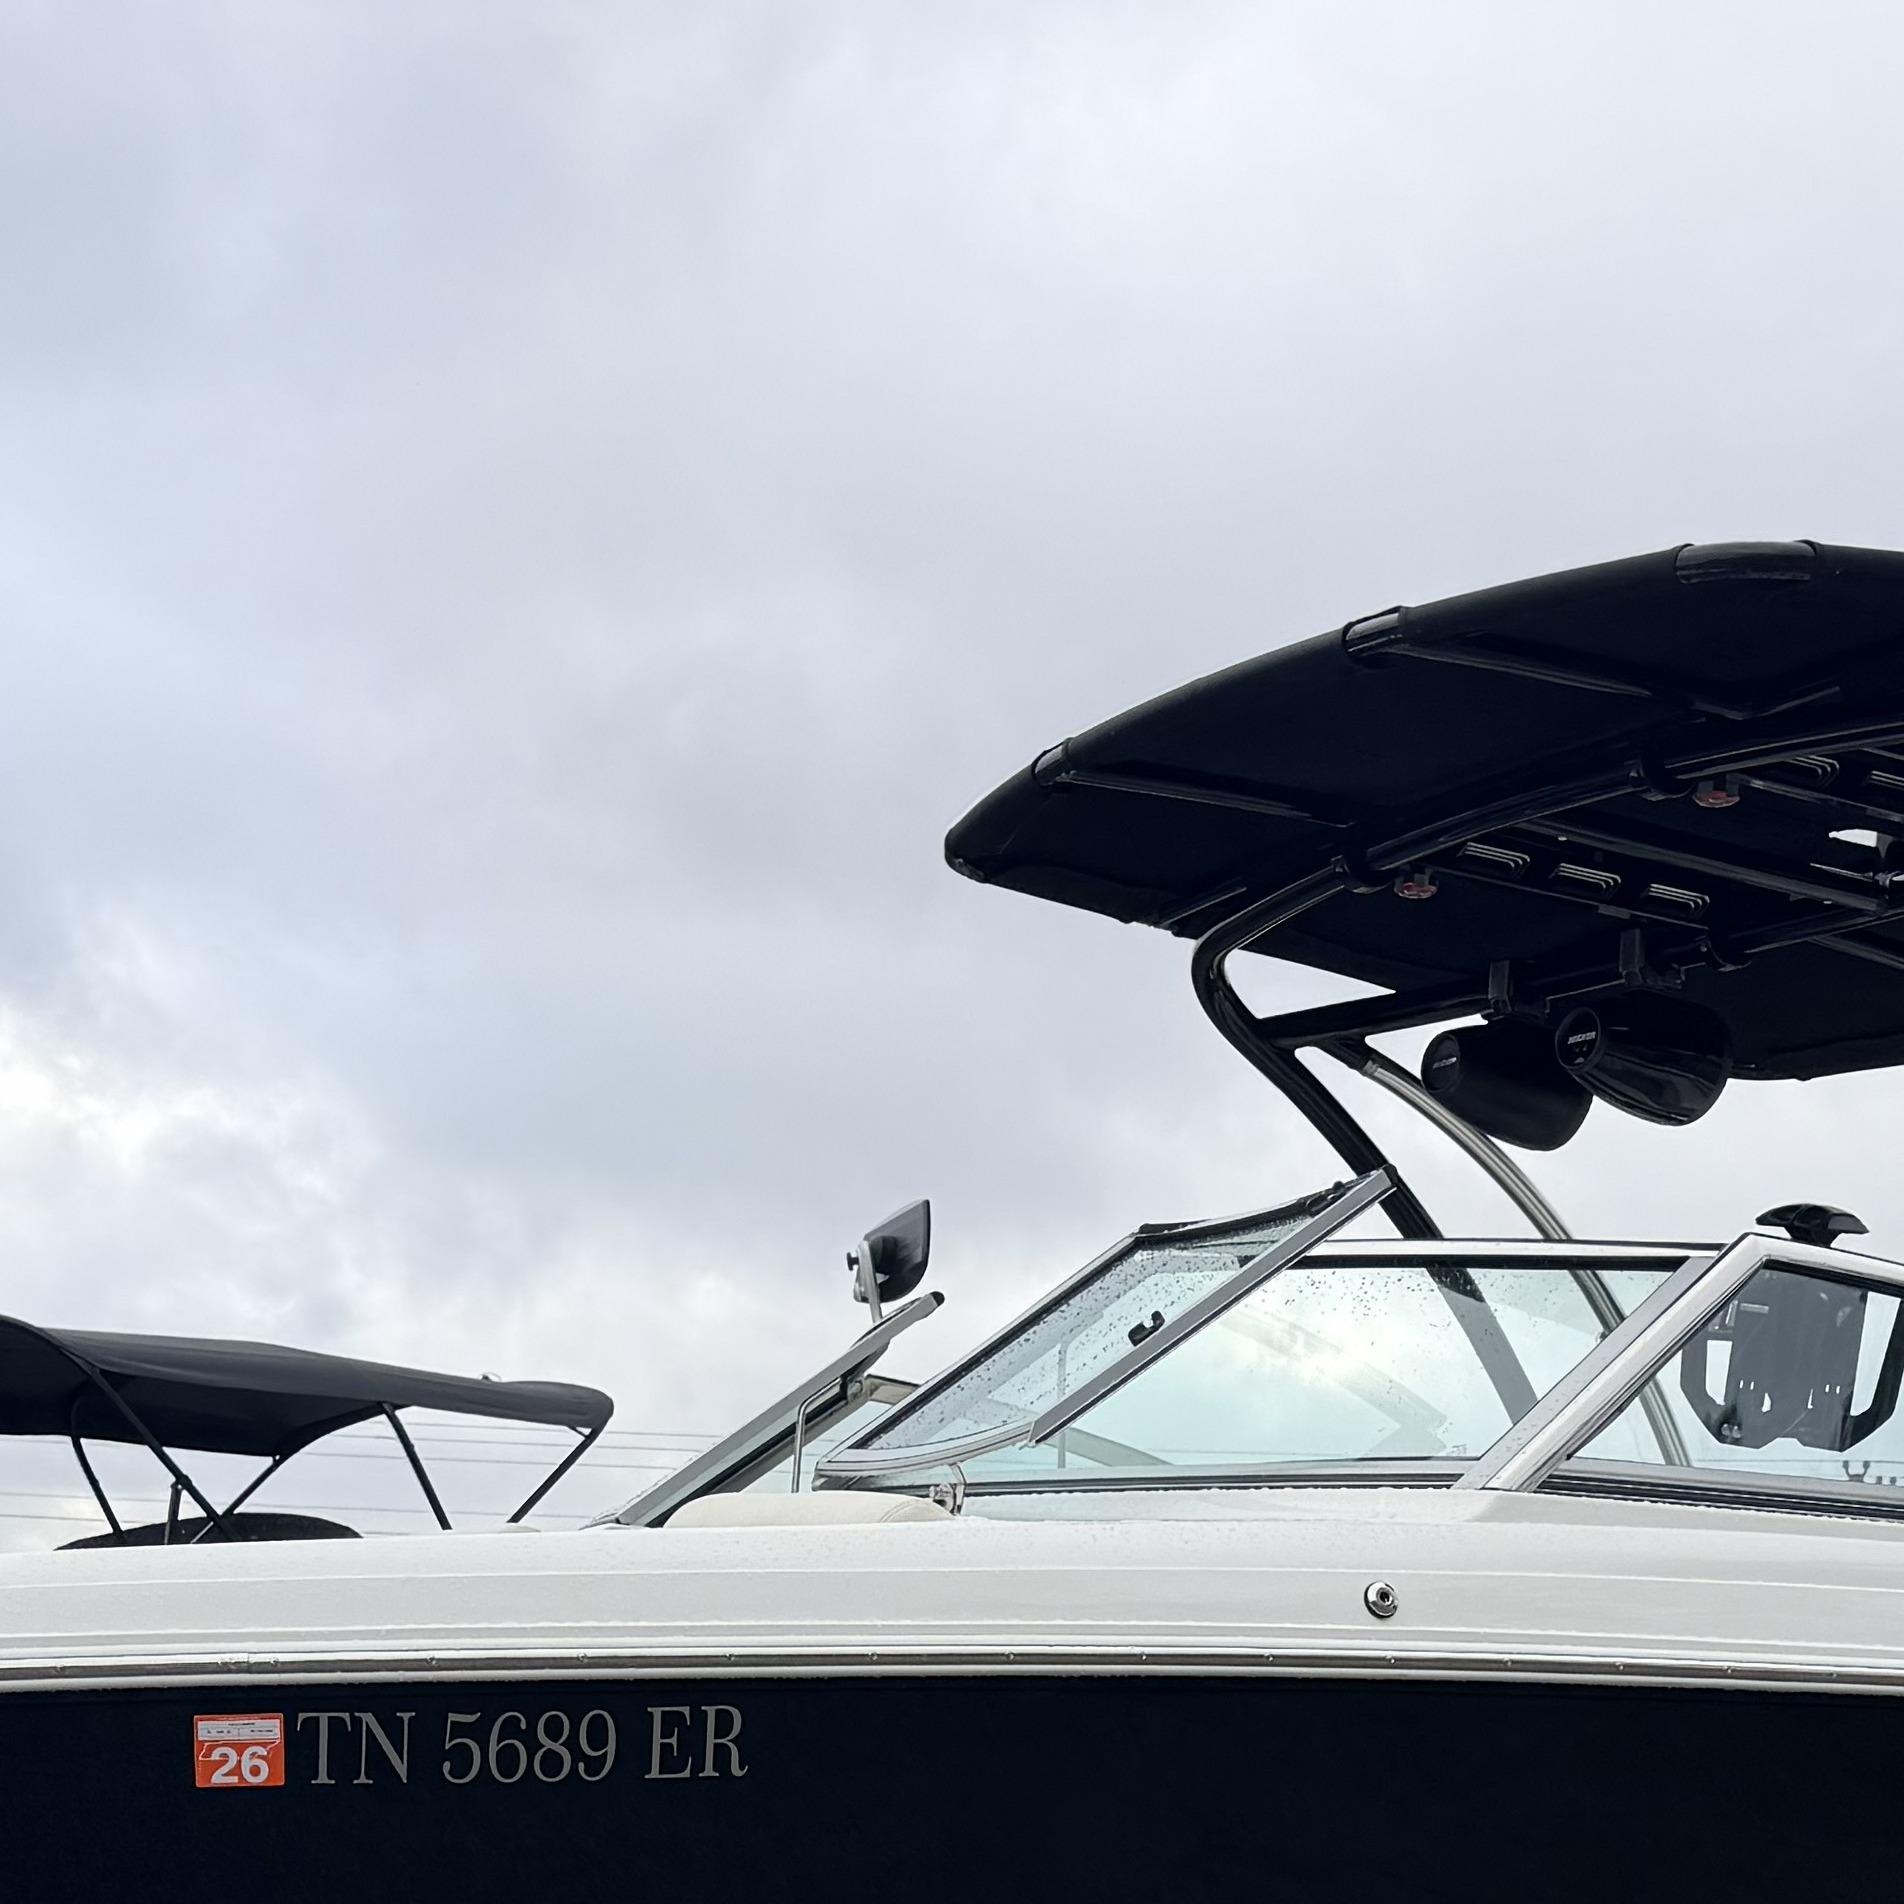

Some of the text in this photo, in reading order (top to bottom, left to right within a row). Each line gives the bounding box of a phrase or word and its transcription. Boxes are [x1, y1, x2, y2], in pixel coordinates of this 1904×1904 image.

[210, 1745, 270, 1785] 26
[297, 1704, 749, 1785] TN 5689 ER
